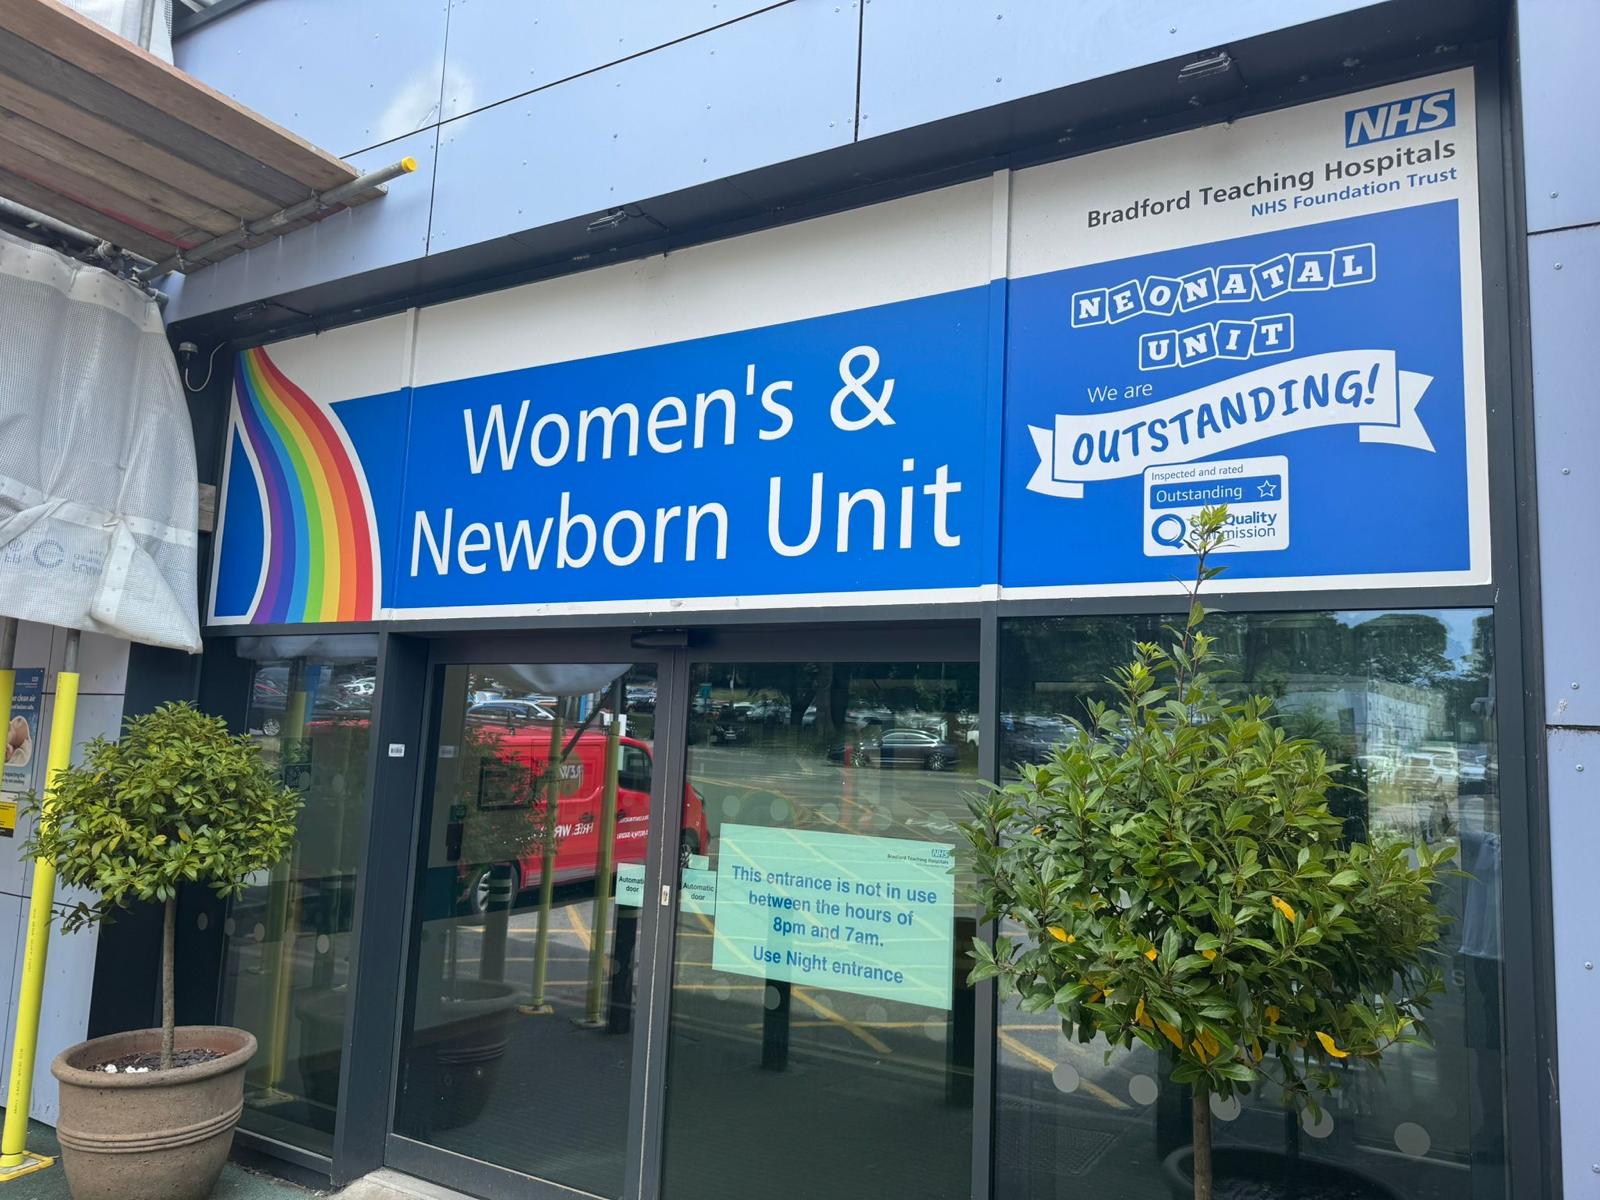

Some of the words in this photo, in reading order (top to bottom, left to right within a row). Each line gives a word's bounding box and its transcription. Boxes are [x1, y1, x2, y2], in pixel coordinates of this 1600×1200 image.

[1348, 93, 1451, 146] NHS
[1087, 191, 1191, 228] Bradford
[1199, 169, 1315, 207] Teaching
[1324, 140, 1456, 181] Hospitals
[1251, 199, 1287, 218] NHS
[1293, 179, 1400, 210] Foundation
[1407, 167, 1457, 189] Trust
[1077, 254, 1363, 320] NEONATAL
[1148, 323, 1284, 361] UNIT
[463, 364, 793, 475] Women's
[830, 345, 896, 432] &
[1087, 386, 1122, 403] We
[1124, 383, 1153, 400] are
[1072, 363, 1381, 465] OUTSTANDING!
[1151, 468, 1196, 483] Inspected
[1198, 466, 1216, 477] and
[1219, 464, 1244, 475] rated
[1156, 485, 1242, 503] Outstanding
[410, 491, 729, 577] Newborn
[767, 458, 962, 557] Unit
[683, 882, 714, 892] Automatic
[690, 893, 706, 901] door
[732, 865, 762, 883] This
[766, 870, 832, 891] entrance
[837, 876, 850, 893] is
[855, 881, 881, 897] not
[887, 883, 901, 900] in
[907, 888, 937, 904] use
[749, 890, 811, 912] between
[816, 898, 840, 916] the
[845, 902, 892, 923] hours
[897, 910, 915, 926] of
[773, 916, 806, 936] 8pm
[811, 924, 839, 940] and
[845, 926, 884, 947] 7am.
[753, 945, 781, 964] Use
[786, 950, 828, 973] Night
[832, 960, 904, 984] entrance
